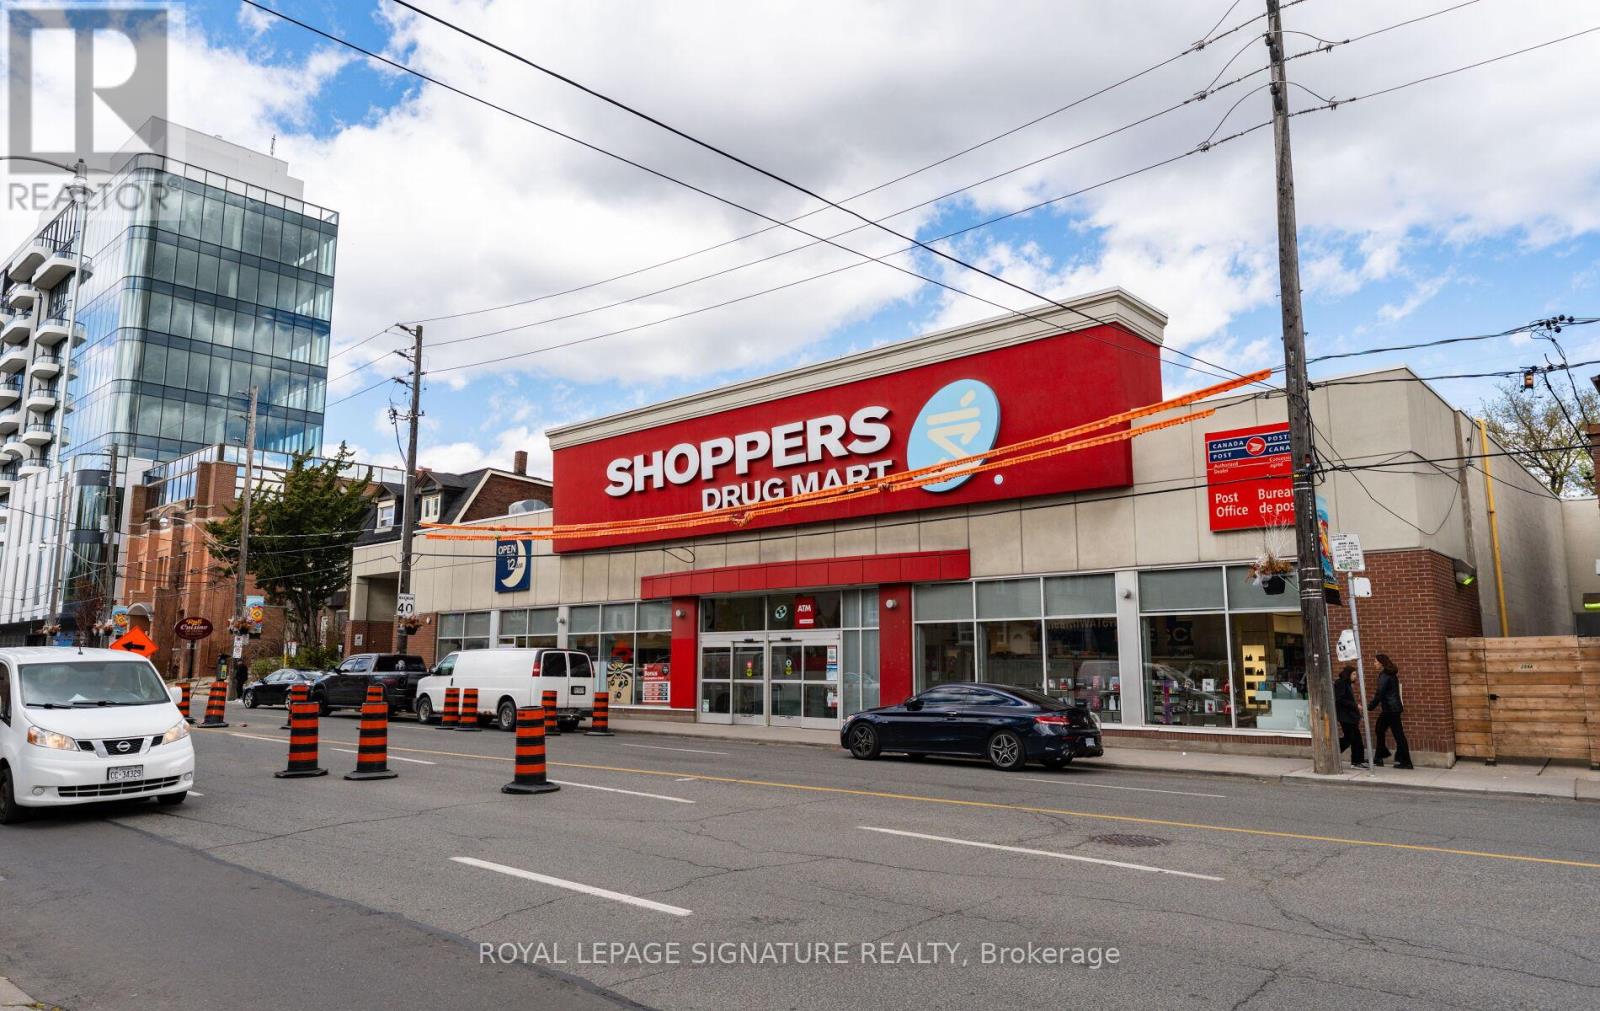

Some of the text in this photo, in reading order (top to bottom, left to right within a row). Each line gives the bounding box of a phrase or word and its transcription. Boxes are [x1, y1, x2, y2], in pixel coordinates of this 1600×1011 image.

[1212, 440, 1244, 450] CANADA
[604, 405, 892, 497] SHOPPERS
[701, 459, 894, 512] DRUG MART
[1215, 492, 1239, 504] Post
[1216, 505, 1249, 518] Office
[1259, 502, 1273, 513] de
[498, 545, 517, 555] OPEN
[507, 558, 515, 571] 12
[397, 603, 413, 614] 40
[797, 604, 812, 612] ATM
